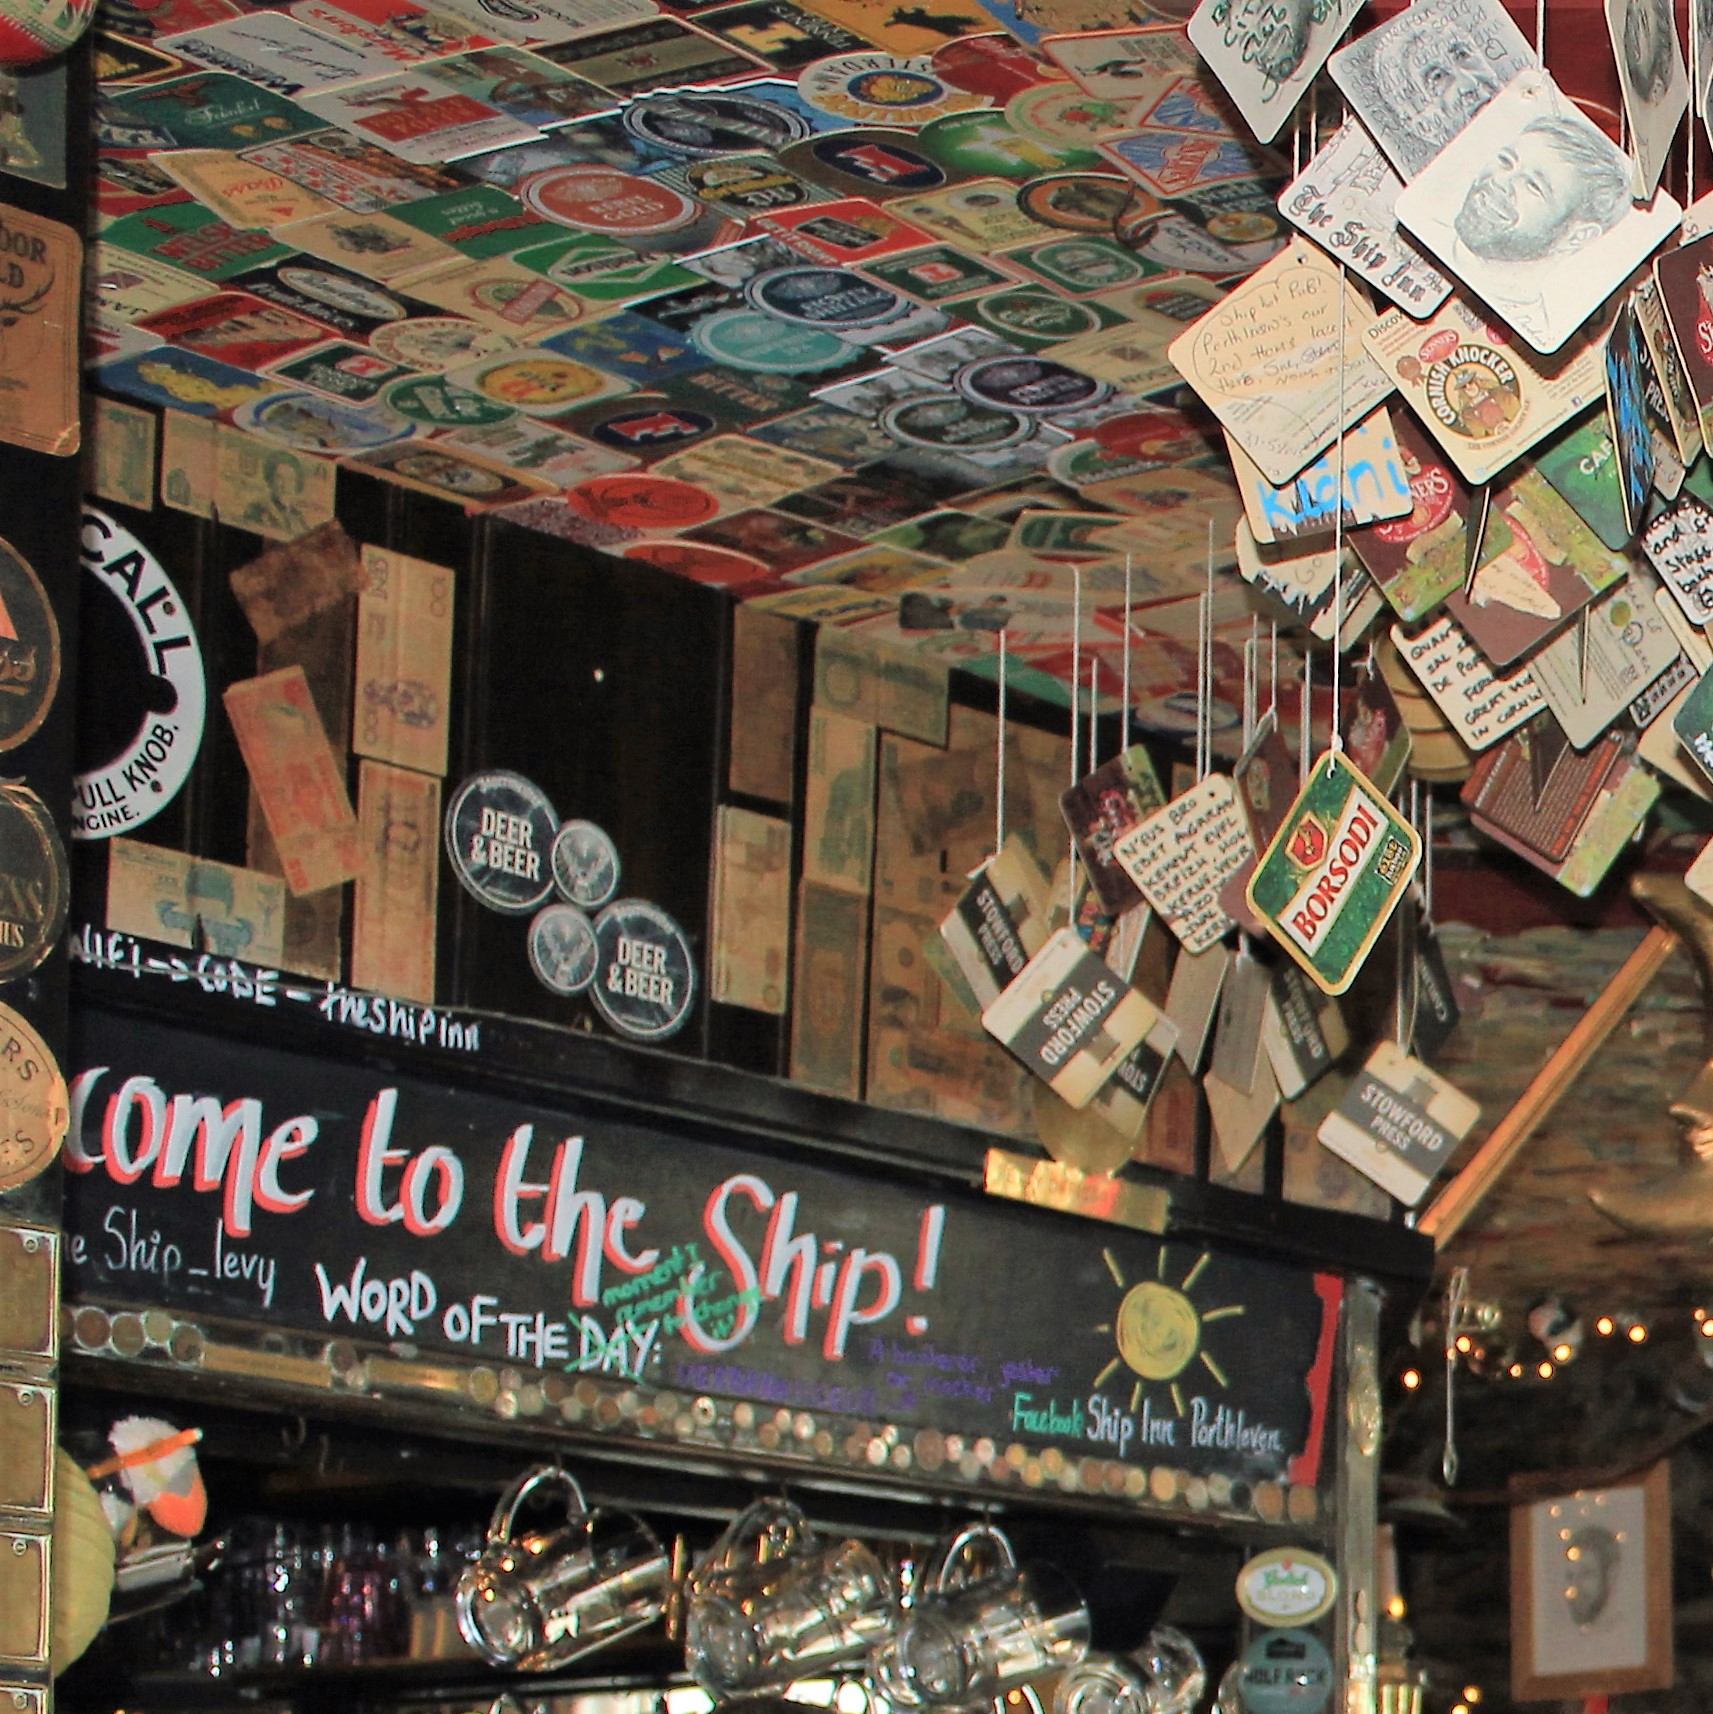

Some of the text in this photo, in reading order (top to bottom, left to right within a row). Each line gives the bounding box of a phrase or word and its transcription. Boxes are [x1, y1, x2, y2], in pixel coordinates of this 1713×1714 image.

[1447, 342, 1518, 386] KNOCKER
[122, 722, 181, 790] KNOB.
[73, 806, 142, 832] NGINE.
[481, 806, 534, 850] DEER
[488, 838, 541, 883] BEER
[1292, 803, 1389, 944] BORSODI
[617, 936, 668, 975] DEER
[624, 966, 675, 1007] BEER
[1042, 986, 1083, 1030] PRESS
[1039, 979, 1117, 1067] STOWFORD
[1361, 1082, 1444, 1152] STOWFORD
[1369, 1114, 1412, 1153] PRESS
[355, 1087, 947, 1362] to the Ship!
[314, 1257, 437, 1336] WORD
[442, 1295, 500, 1350] OF
[498, 1311, 571, 1362] THE
[1011, 1391, 1085, 1438] Facebook
[1085, 1399, 1137, 1456] Ship
[1139, 1400, 1176, 1442] Inn
